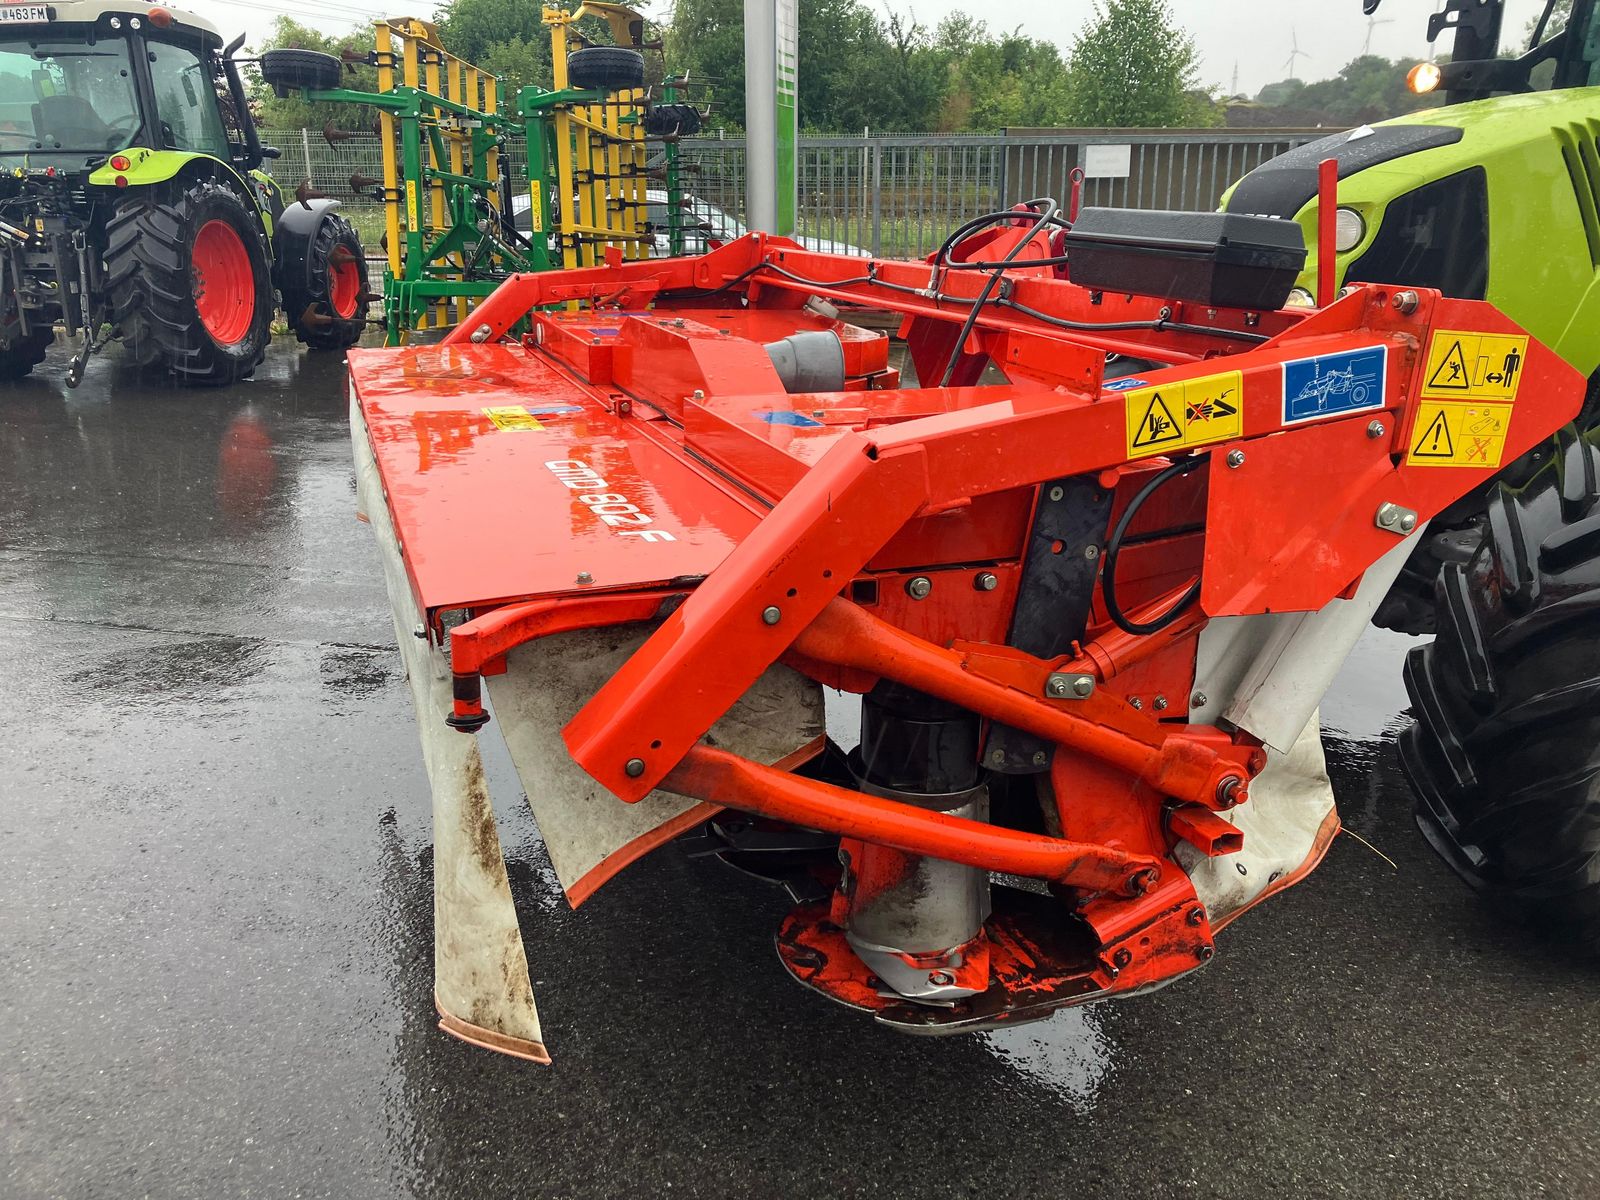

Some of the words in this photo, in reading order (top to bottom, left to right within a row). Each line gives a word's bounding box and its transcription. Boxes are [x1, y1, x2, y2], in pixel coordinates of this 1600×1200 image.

[543, 459, 609, 489] GMD
[577, 493, 654, 526] 802
[617, 529, 678, 542] F
